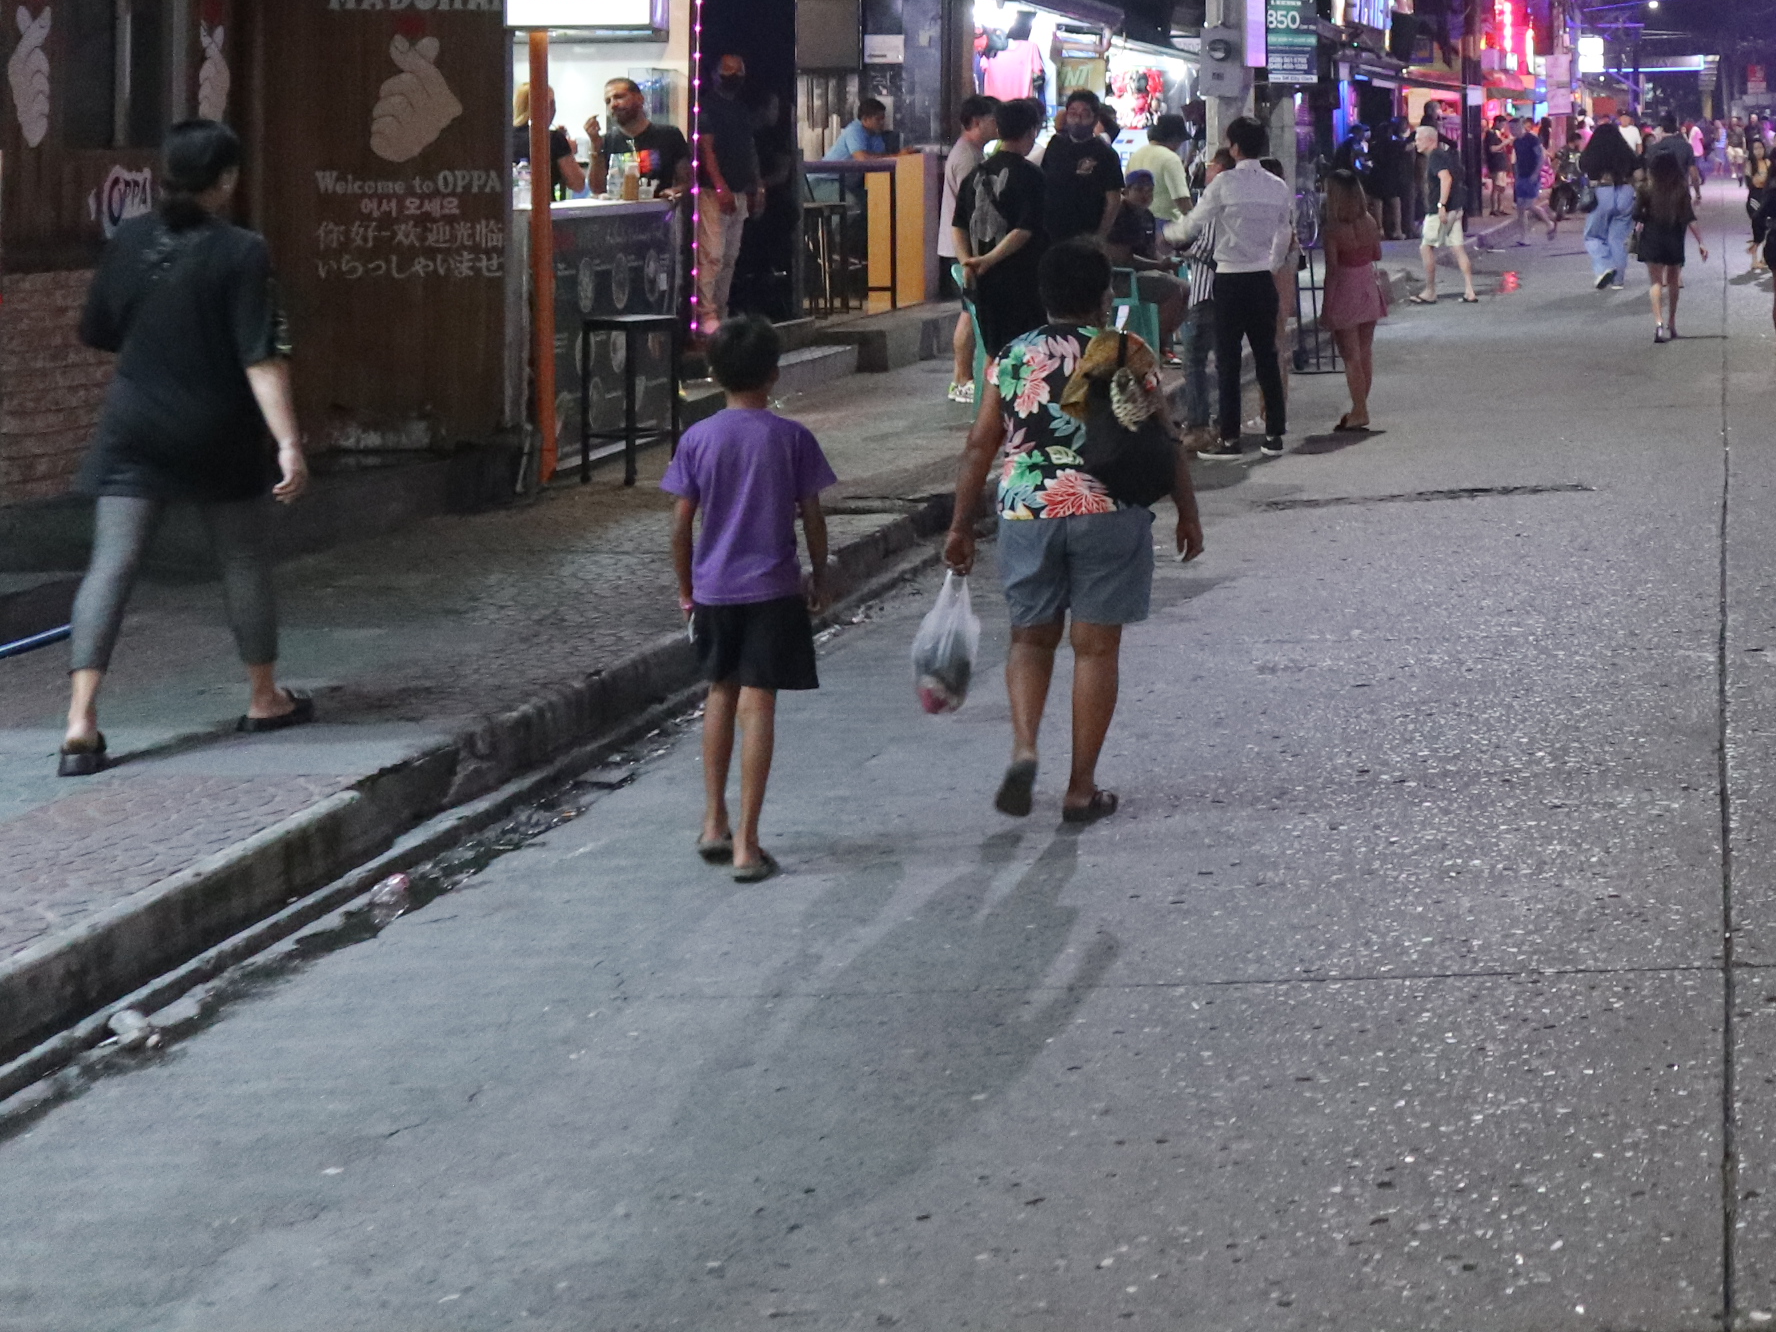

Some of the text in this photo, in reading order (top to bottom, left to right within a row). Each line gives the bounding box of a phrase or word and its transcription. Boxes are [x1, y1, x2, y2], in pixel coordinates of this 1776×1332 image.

[315, 169, 501, 195] Welcome to OPPA
[360, 195, 461, 219] 어서 오세요
